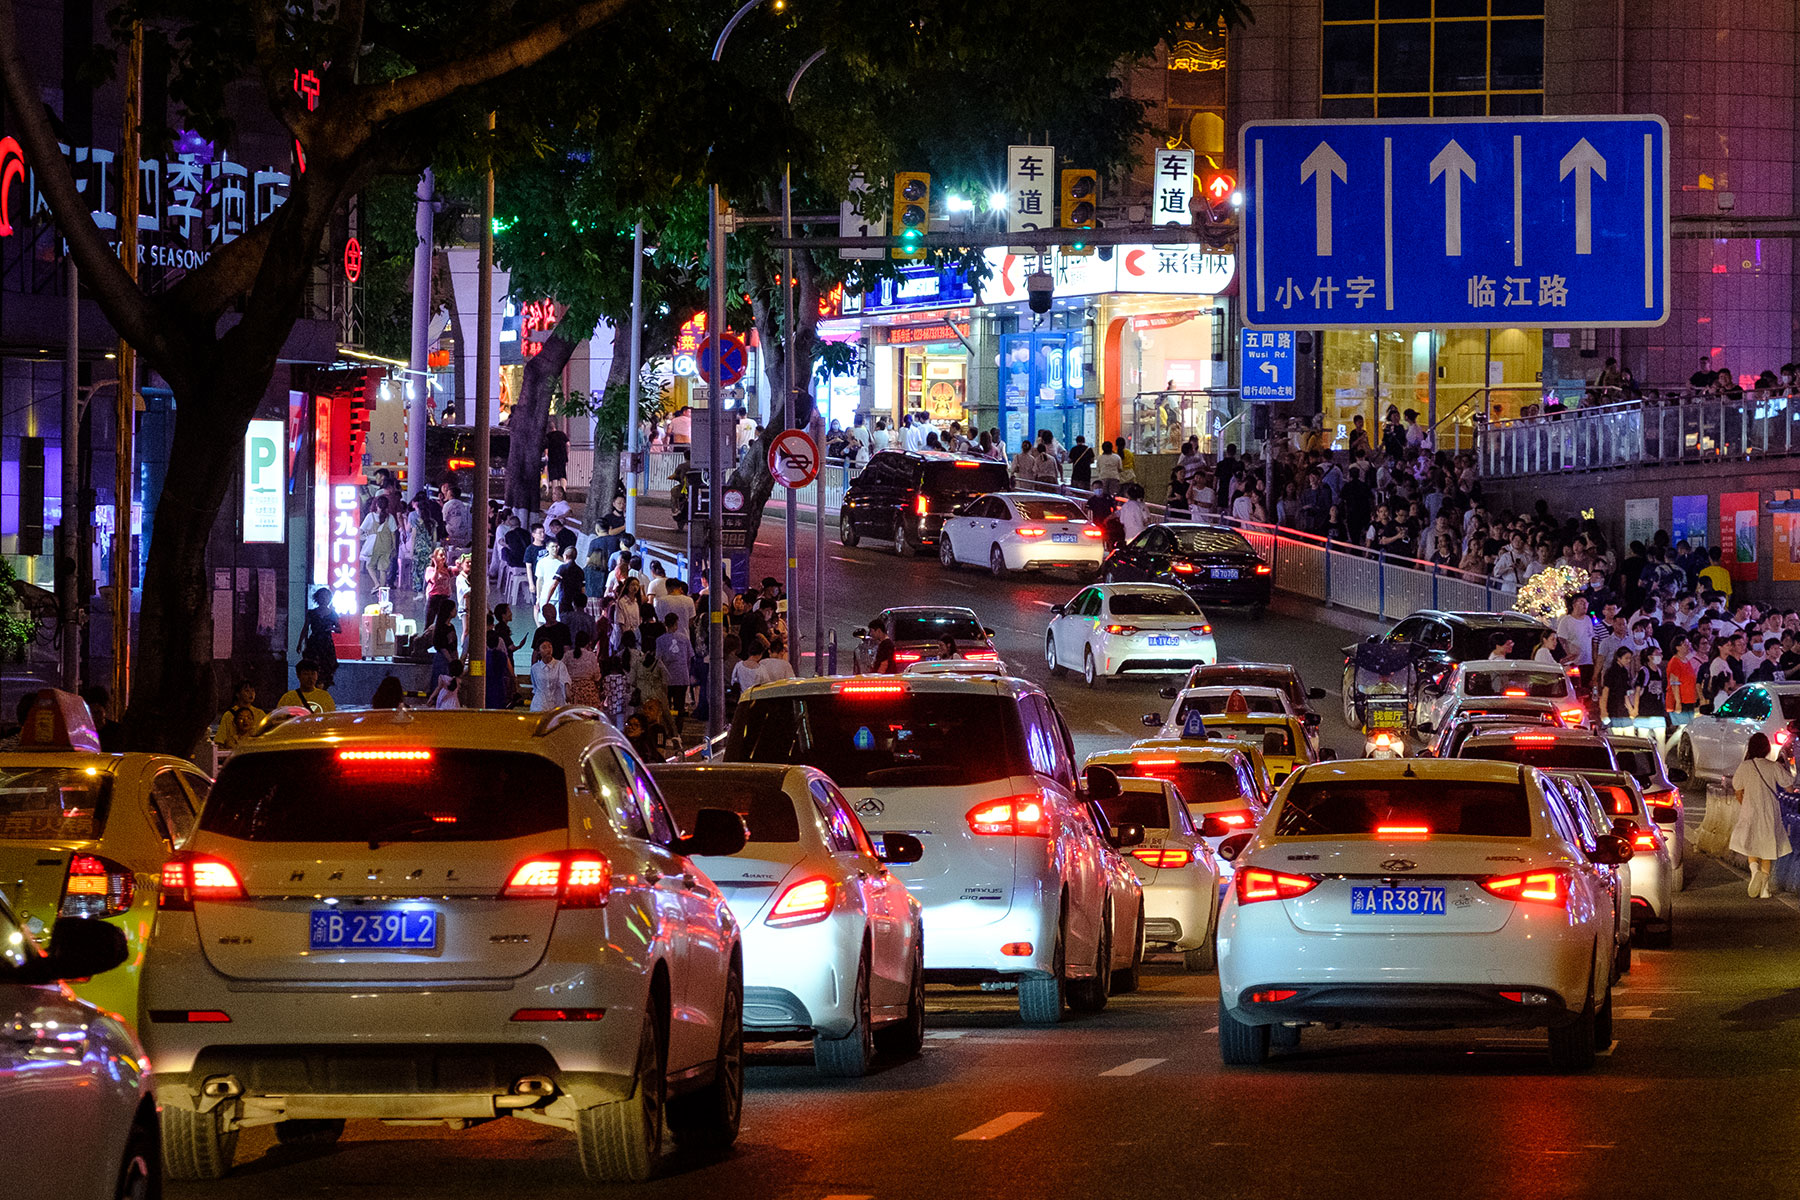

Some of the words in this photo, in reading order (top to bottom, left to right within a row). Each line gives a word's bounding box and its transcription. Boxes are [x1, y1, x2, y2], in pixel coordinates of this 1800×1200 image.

[1158, 252, 1228, 274] 莱得快
[1274, 276, 1376, 309] 小什字
[1467, 274, 1569, 308] 临江路
[1245, 332, 1291, 349] 五四路
[1243, 385, 1293, 396] 前行400m左转
[251, 437, 277, 484] P
[332, 485, 359, 615] 巴九门火锅
[1353, 890, 1443, 911] 渝A·R387K
[313, 915, 433, 944] 渝B·239L2
